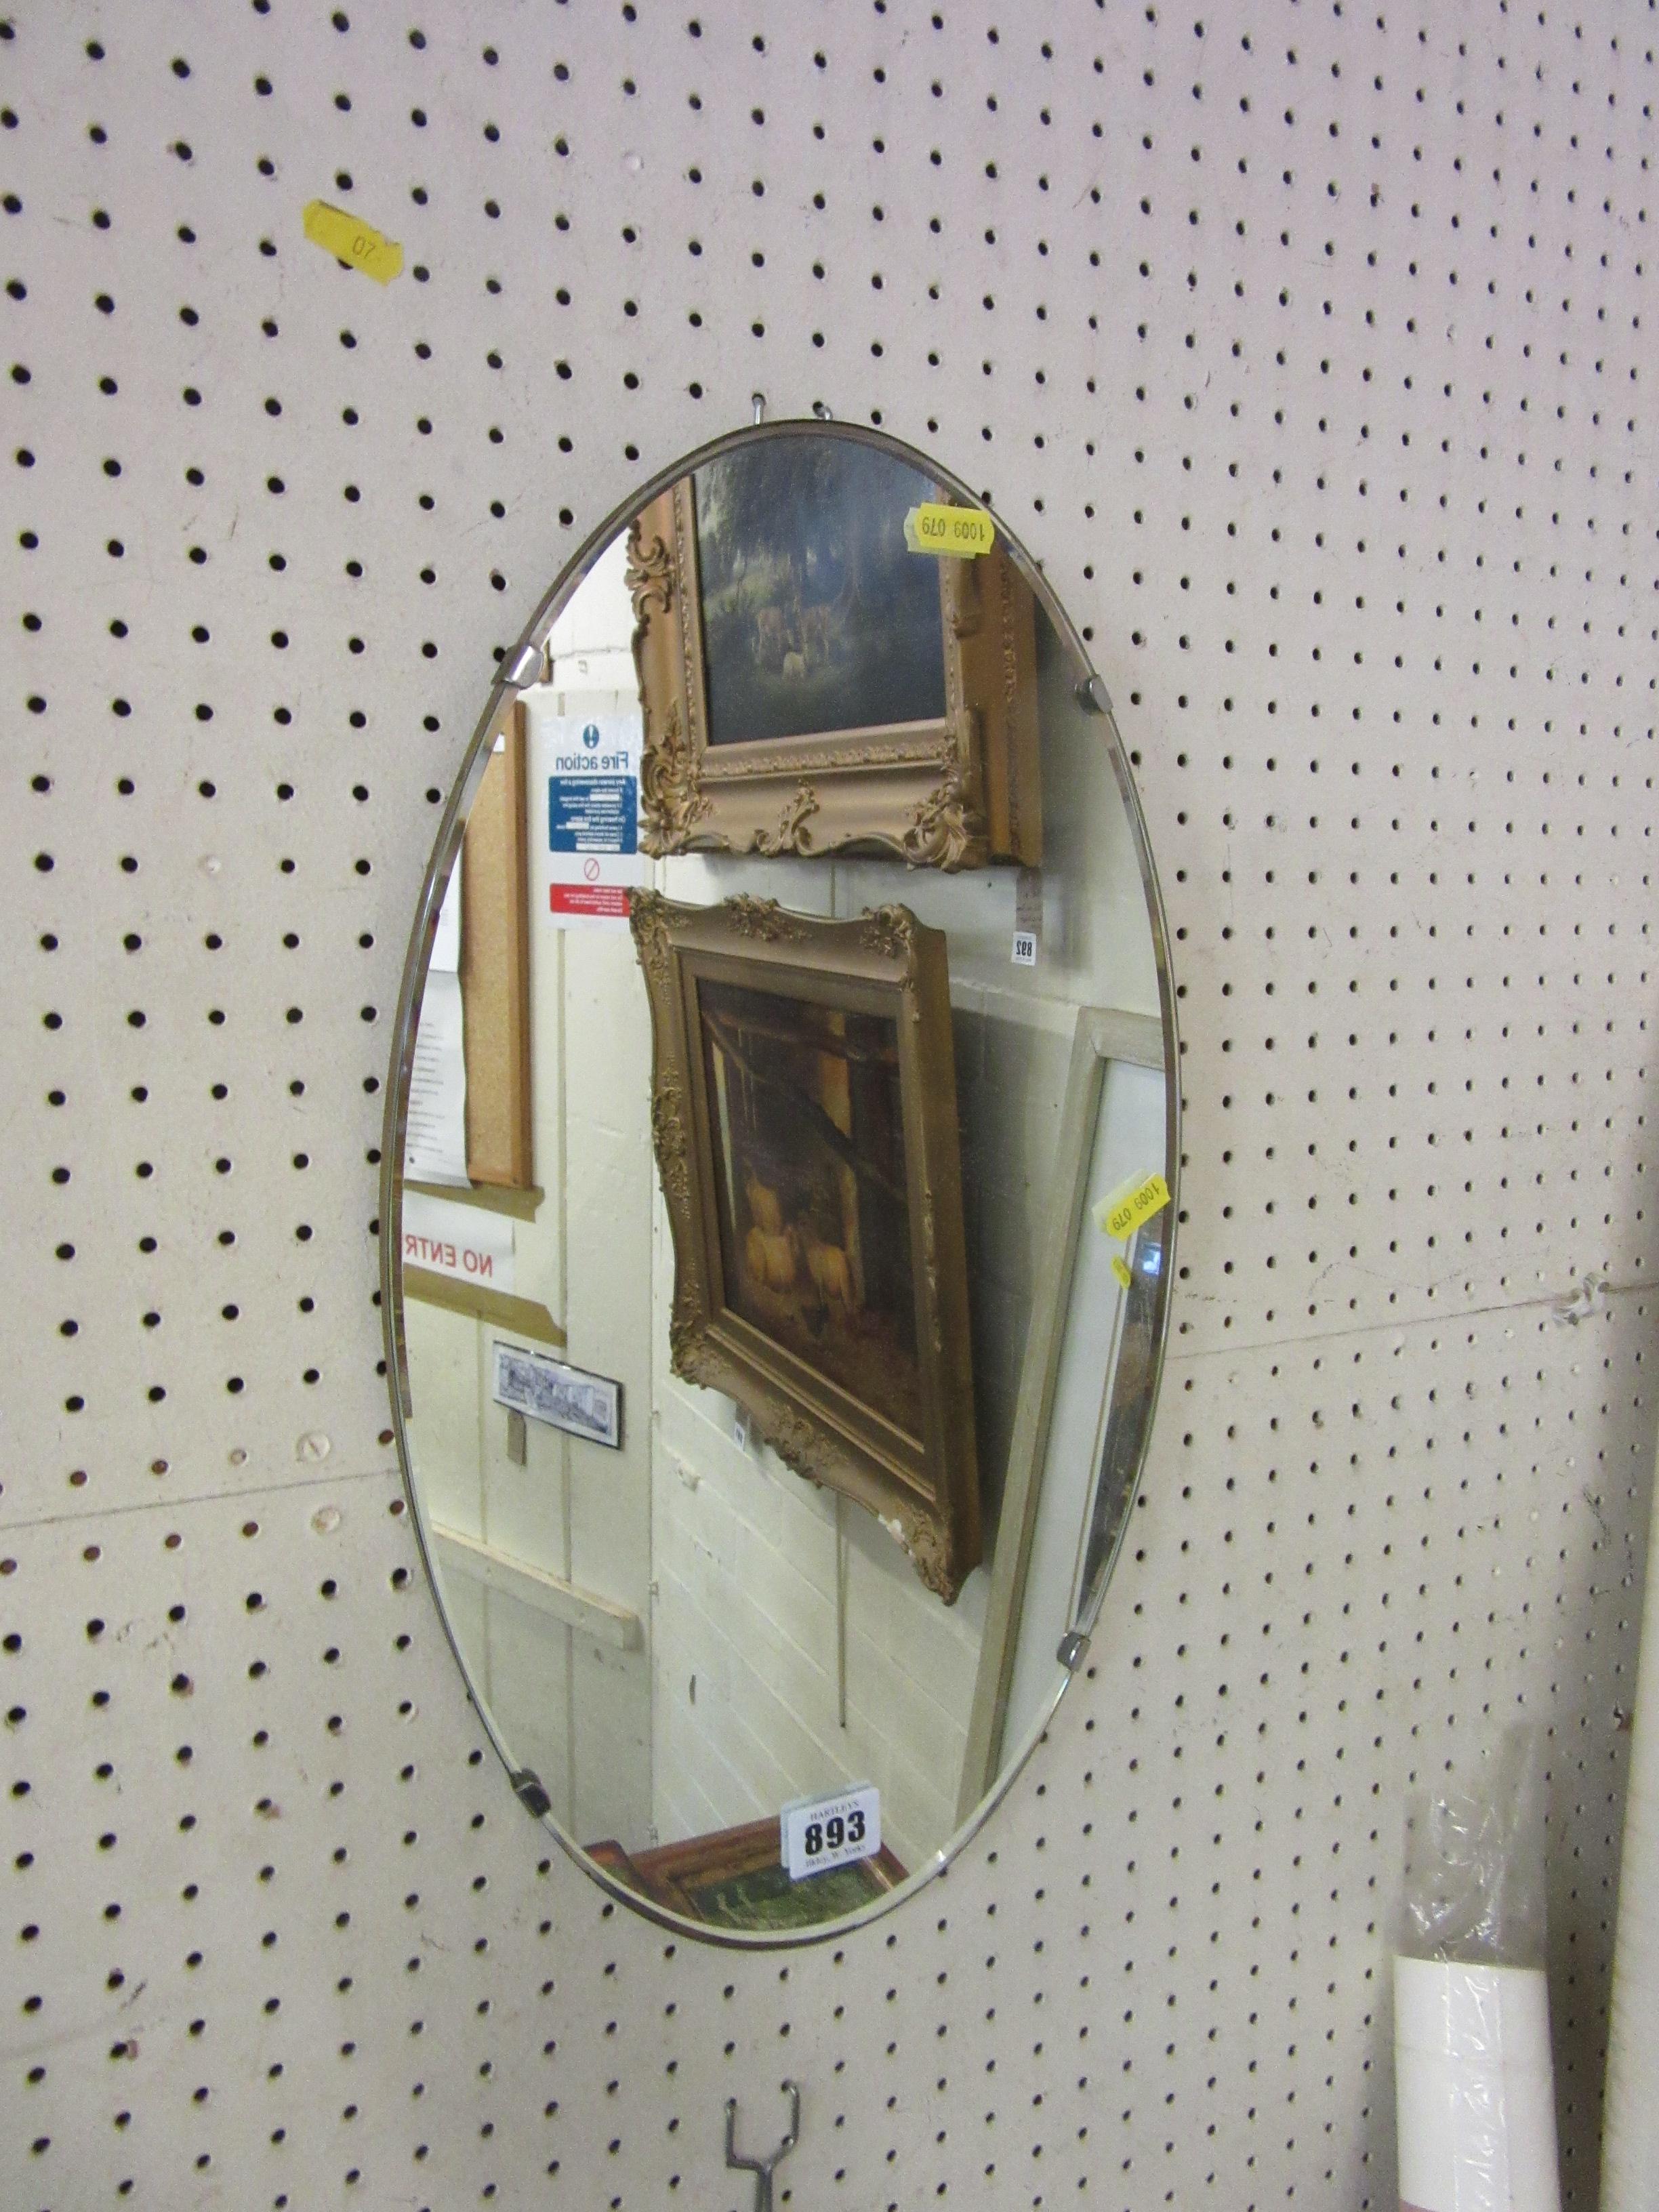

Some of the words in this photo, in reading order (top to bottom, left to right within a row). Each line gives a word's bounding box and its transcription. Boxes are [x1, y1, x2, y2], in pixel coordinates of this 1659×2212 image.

[922, 517, 946, 537] 079
[954, 520, 985, 541] 1009
[1134, 1183, 1160, 1210] 1009
[1112, 1208, 1132, 1231] 079
[804, 1810, 866, 1856] 893
